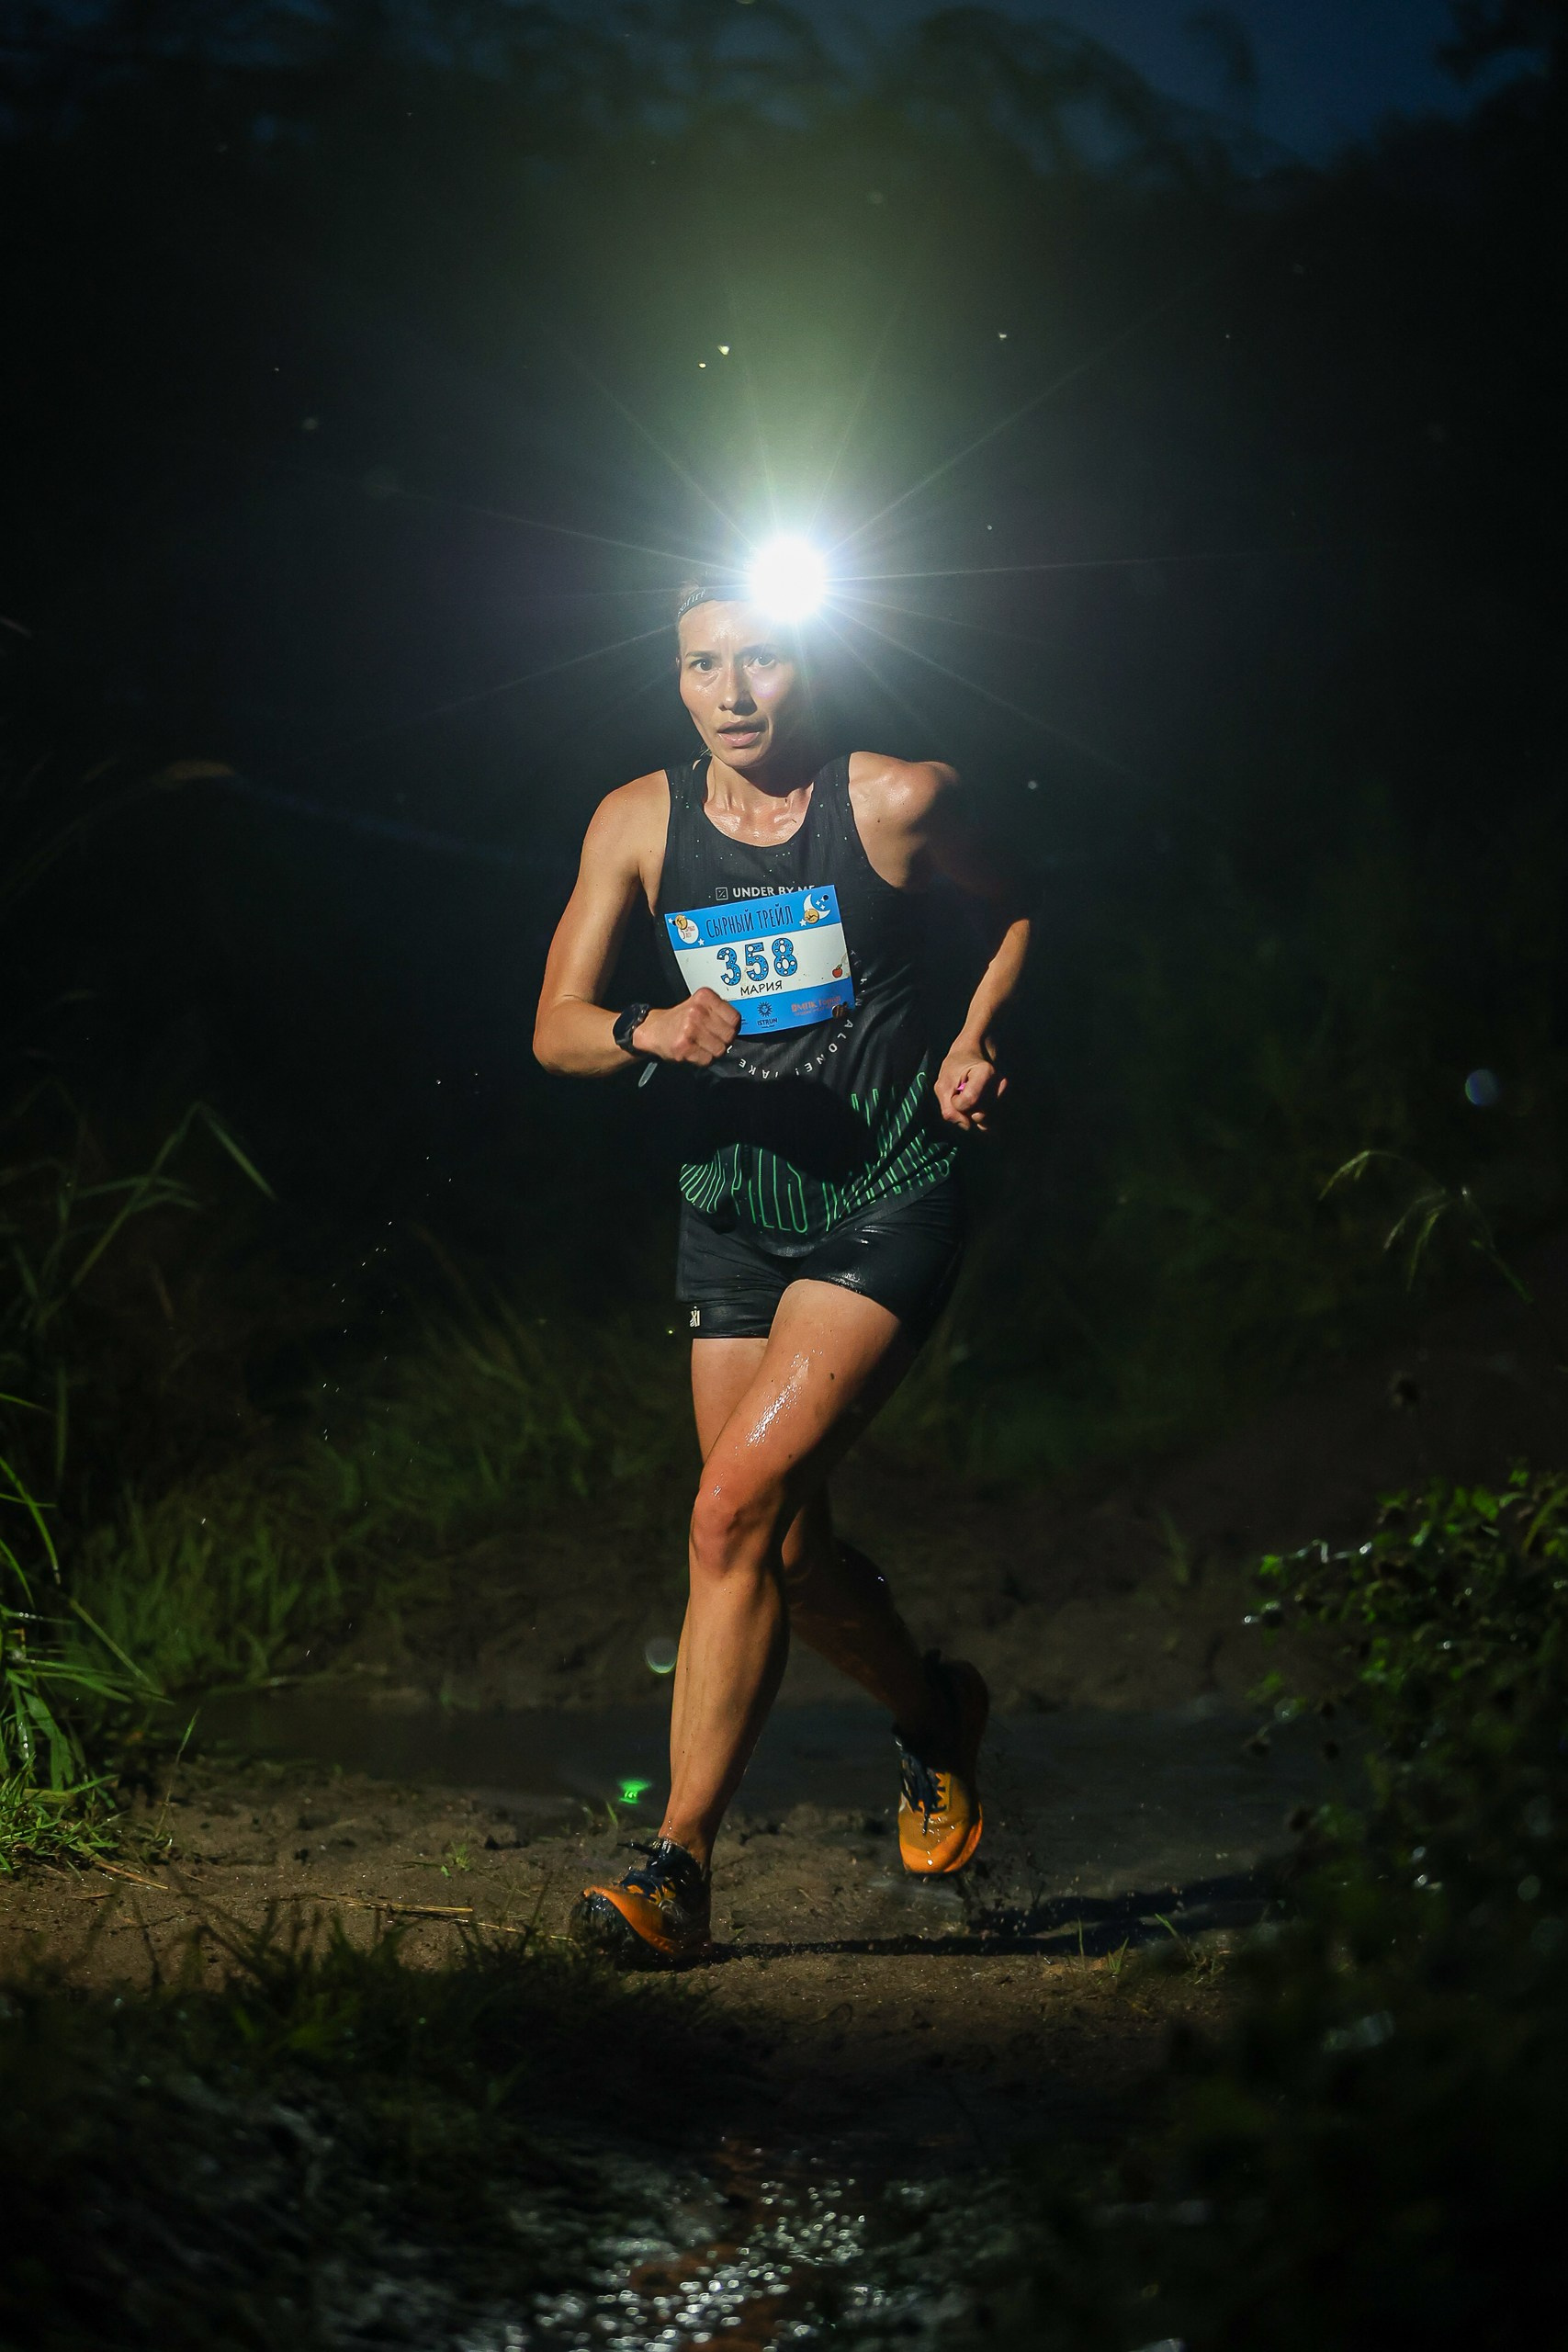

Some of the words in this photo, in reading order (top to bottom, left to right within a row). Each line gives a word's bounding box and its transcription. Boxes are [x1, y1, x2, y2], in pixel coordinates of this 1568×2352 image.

[732, 886, 775, 898] UNDER
[706, 909, 755, 939] СЫРНЫЙ
[756, 903, 794, 930] ТРЕЙЛ
[716, 937, 798, 986] 358
[739, 979, 783, 996] МАРИЯ
